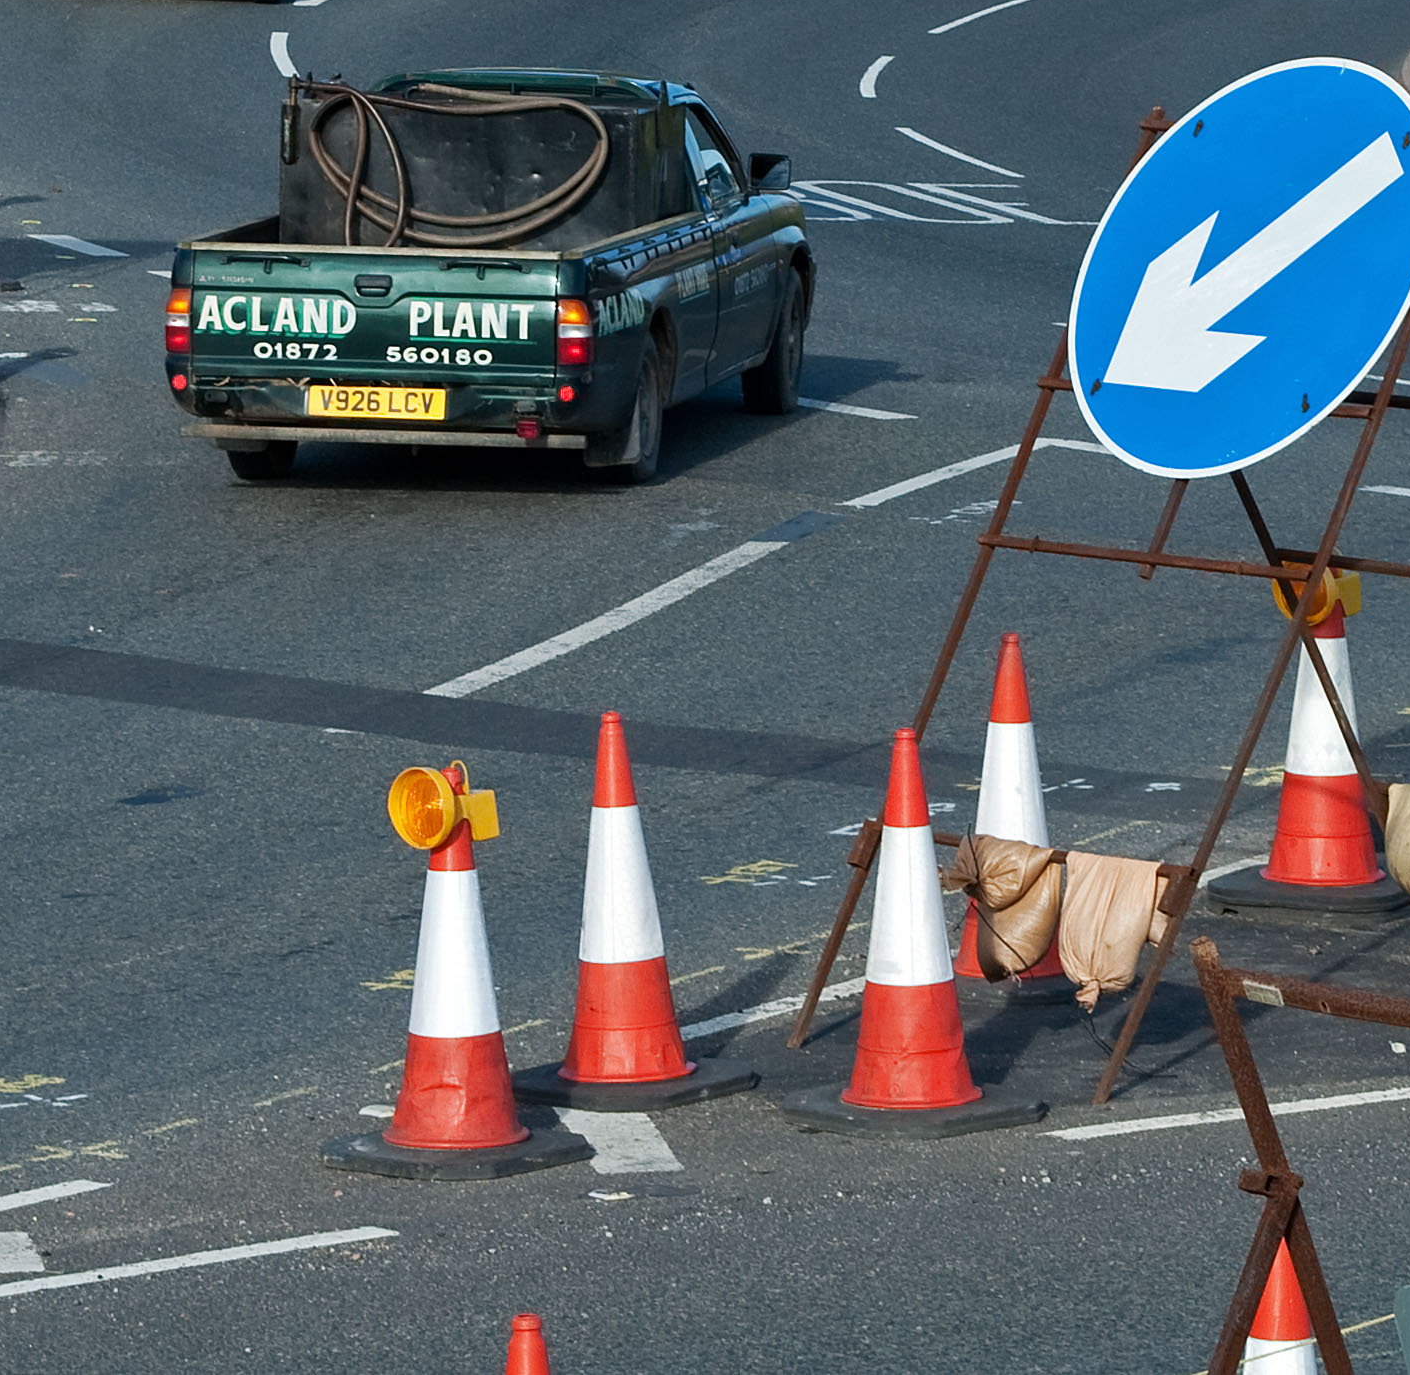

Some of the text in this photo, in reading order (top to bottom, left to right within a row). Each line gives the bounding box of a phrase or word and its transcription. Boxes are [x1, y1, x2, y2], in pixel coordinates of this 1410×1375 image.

[194, 295, 536, 340] ACLAND PLANT
[598, 288, 645, 336] ACLAND
[253, 342, 493, 365] 01872 560180
[320, 390, 436, 414] V926 LCV
